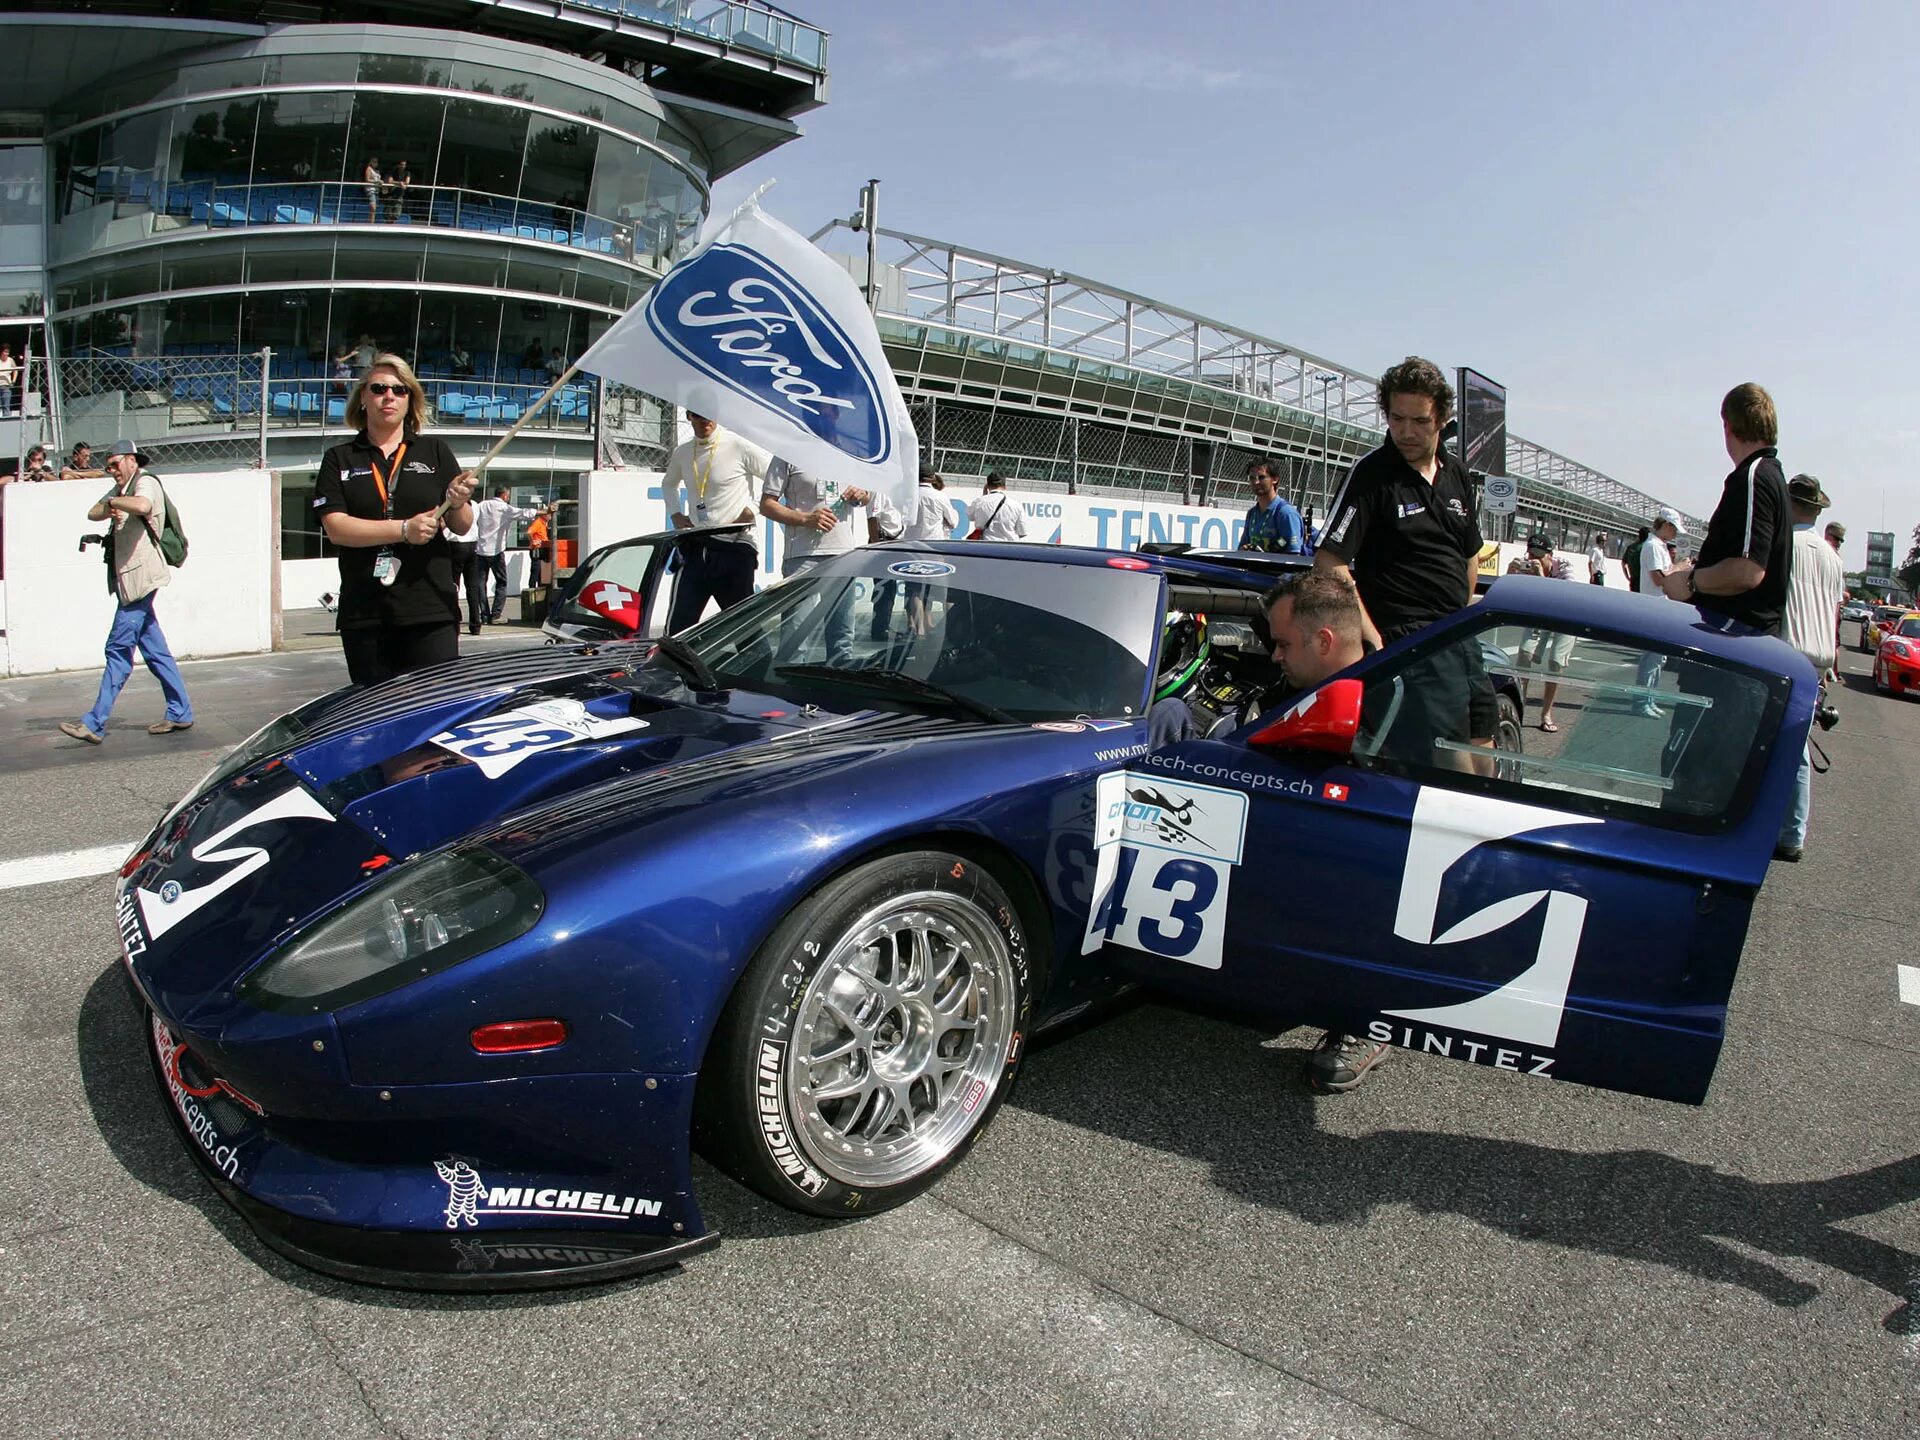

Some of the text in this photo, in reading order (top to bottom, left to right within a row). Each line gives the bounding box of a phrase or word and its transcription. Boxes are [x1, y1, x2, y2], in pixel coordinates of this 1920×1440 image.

[678, 277, 856, 415] Ford
[1022, 502, 1062, 518] IVECO
[116, 894, 147, 965] SINTEZ
[1090, 845, 1219, 957] 43
[1367, 1020, 1556, 1079] SINTEZ
[759, 1043, 806, 1176] MICHELIN
[963, 1082, 984, 1112] BBS
[487, 1187, 663, 1217] MICHELIN
